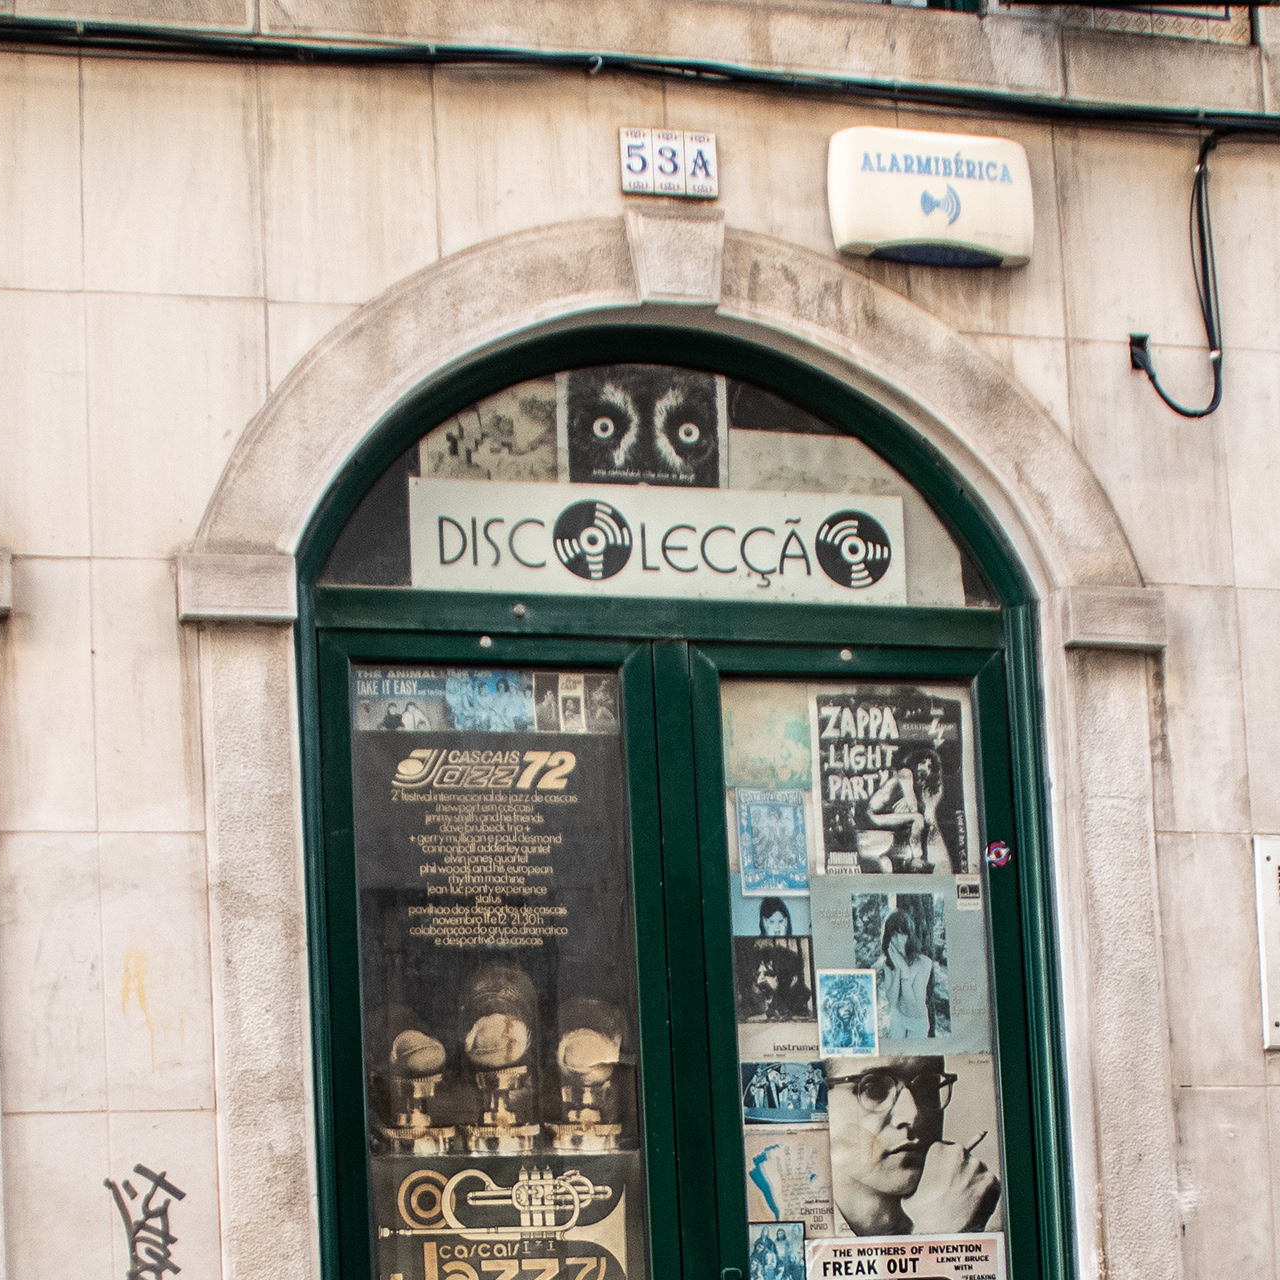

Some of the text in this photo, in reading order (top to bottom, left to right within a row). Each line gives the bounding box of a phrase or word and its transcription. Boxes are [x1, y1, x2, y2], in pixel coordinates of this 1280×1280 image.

[626, 142, 713, 179] 53A
[860, 150, 1013, 184] ALARMIBÉRICA
[357, 681, 378, 695] TAKE
[382, 680, 390, 694] IT
[394, 680, 417, 694] EASY
[820, 706, 899, 739] ZAPPA
[448, 750, 519, 763] CASCAIS
[517, 751, 576, 789] 72
[829, 744, 899, 770] LIGHT
[829, 769, 889, 800] PARTY
[832, 1249, 852, 1257] THE
[857, 1247, 906, 1256] MOTHERS
[929, 1244, 982, 1254] INVENTION
[823, 1258, 919, 1276] FREAK OUT
